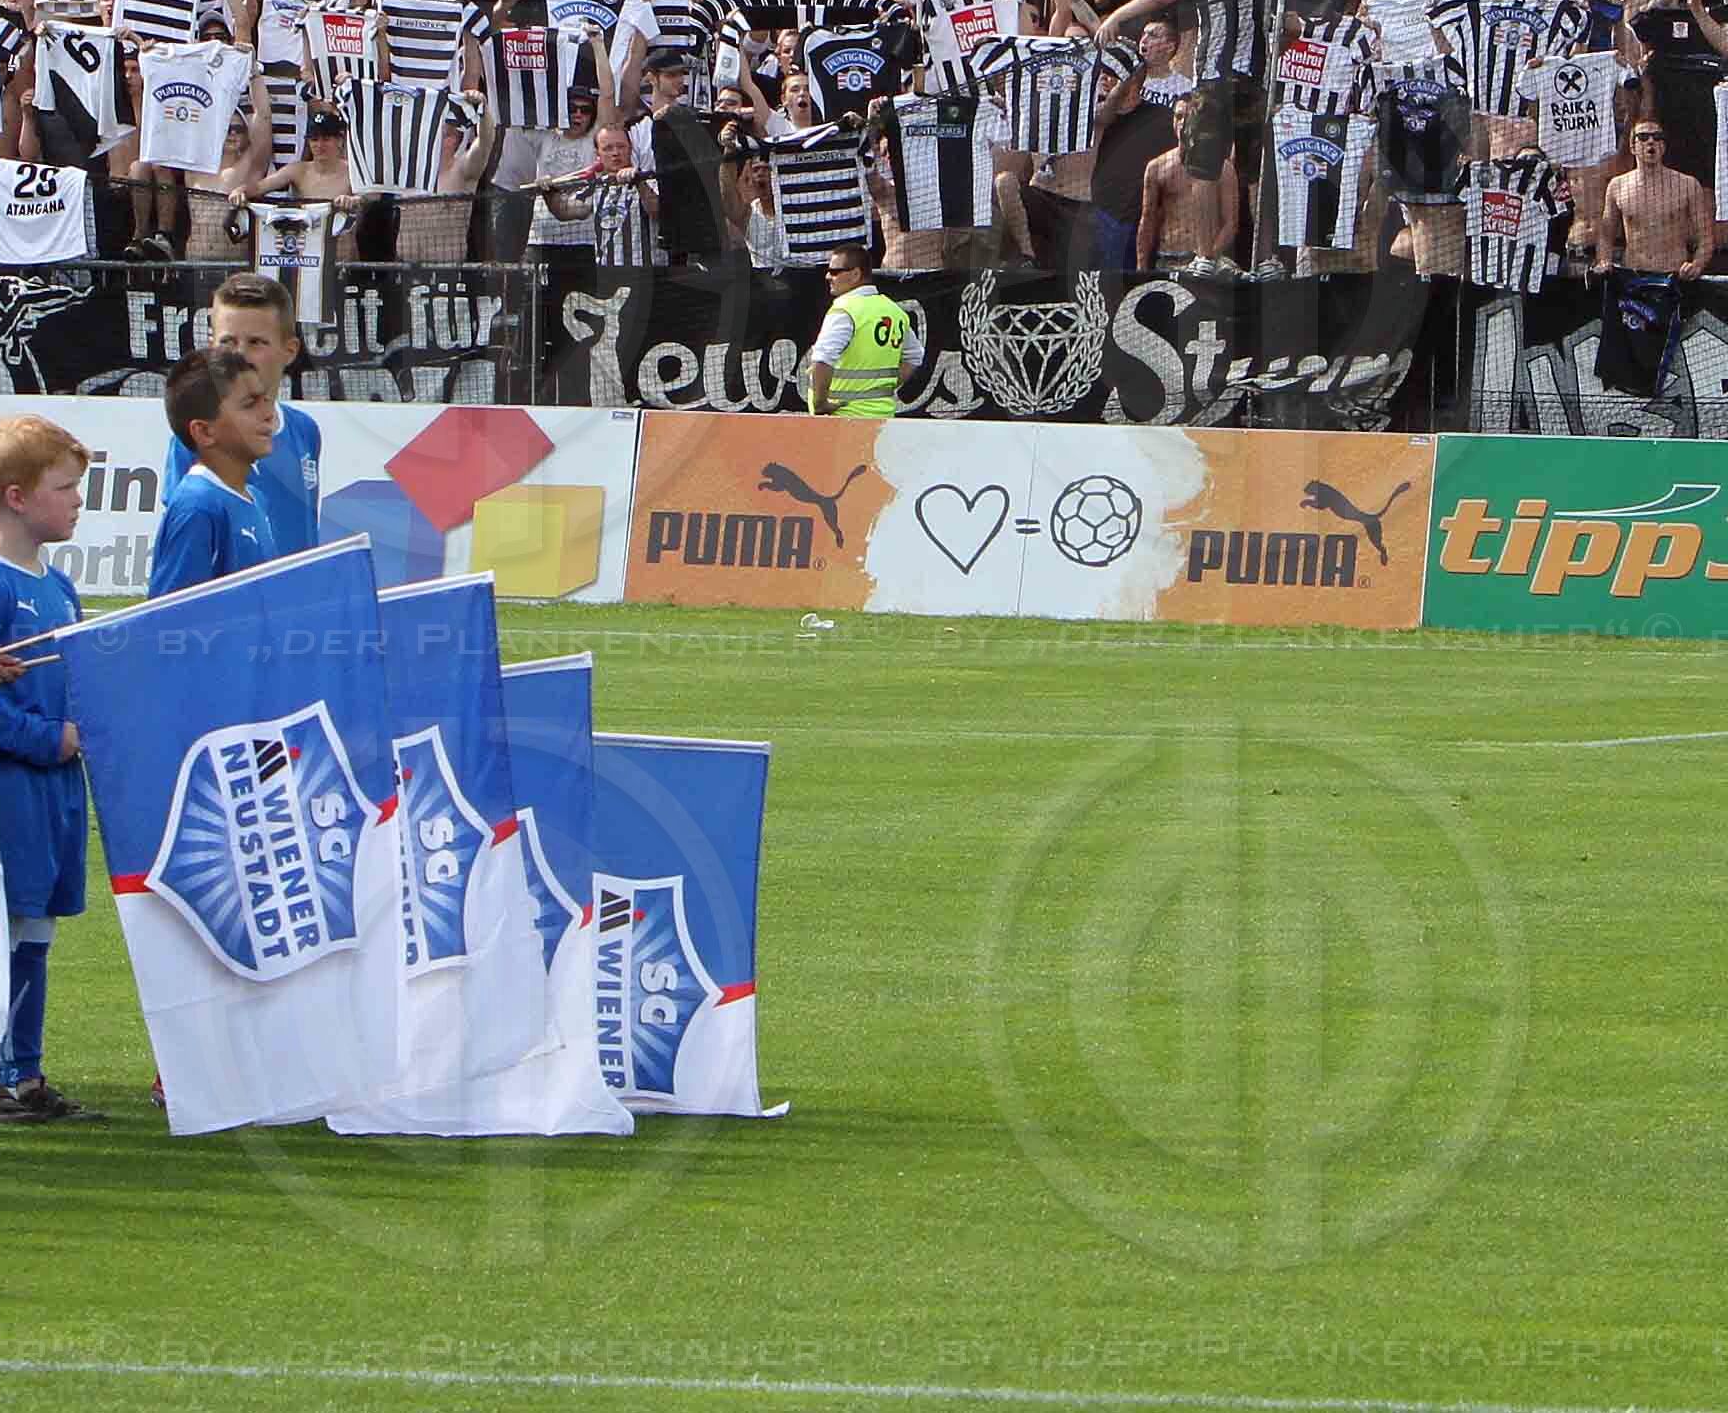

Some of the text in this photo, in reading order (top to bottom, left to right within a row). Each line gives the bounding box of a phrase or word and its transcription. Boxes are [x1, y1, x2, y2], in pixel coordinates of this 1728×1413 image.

[324, 18, 363, 36] Steirer
[551, 0, 618, 29] PUNTIGAMER
[326, 36, 363, 54] Krone
[505, 53, 546, 69] Krone
[153, 83, 214, 109] PUNTIGAMER
[1550, 101, 1597, 118] RAIKA
[1551, 114, 1600, 132] STURM
[4, 198, 66, 217] ATANGANA
[259, 254, 321, 268] PUNTIGAMER
[646, 511, 816, 571] PUMA
[1186, 530, 1359, 589] PUMA
[309, 792, 353, 866] SC
[219, 741, 292, 962] NEUSTADT
[418, 818, 460, 887] SC
[262, 783, 321, 955] WIENER
[639, 960, 679, 1029] SC
[596, 941, 629, 1093] WIENER
